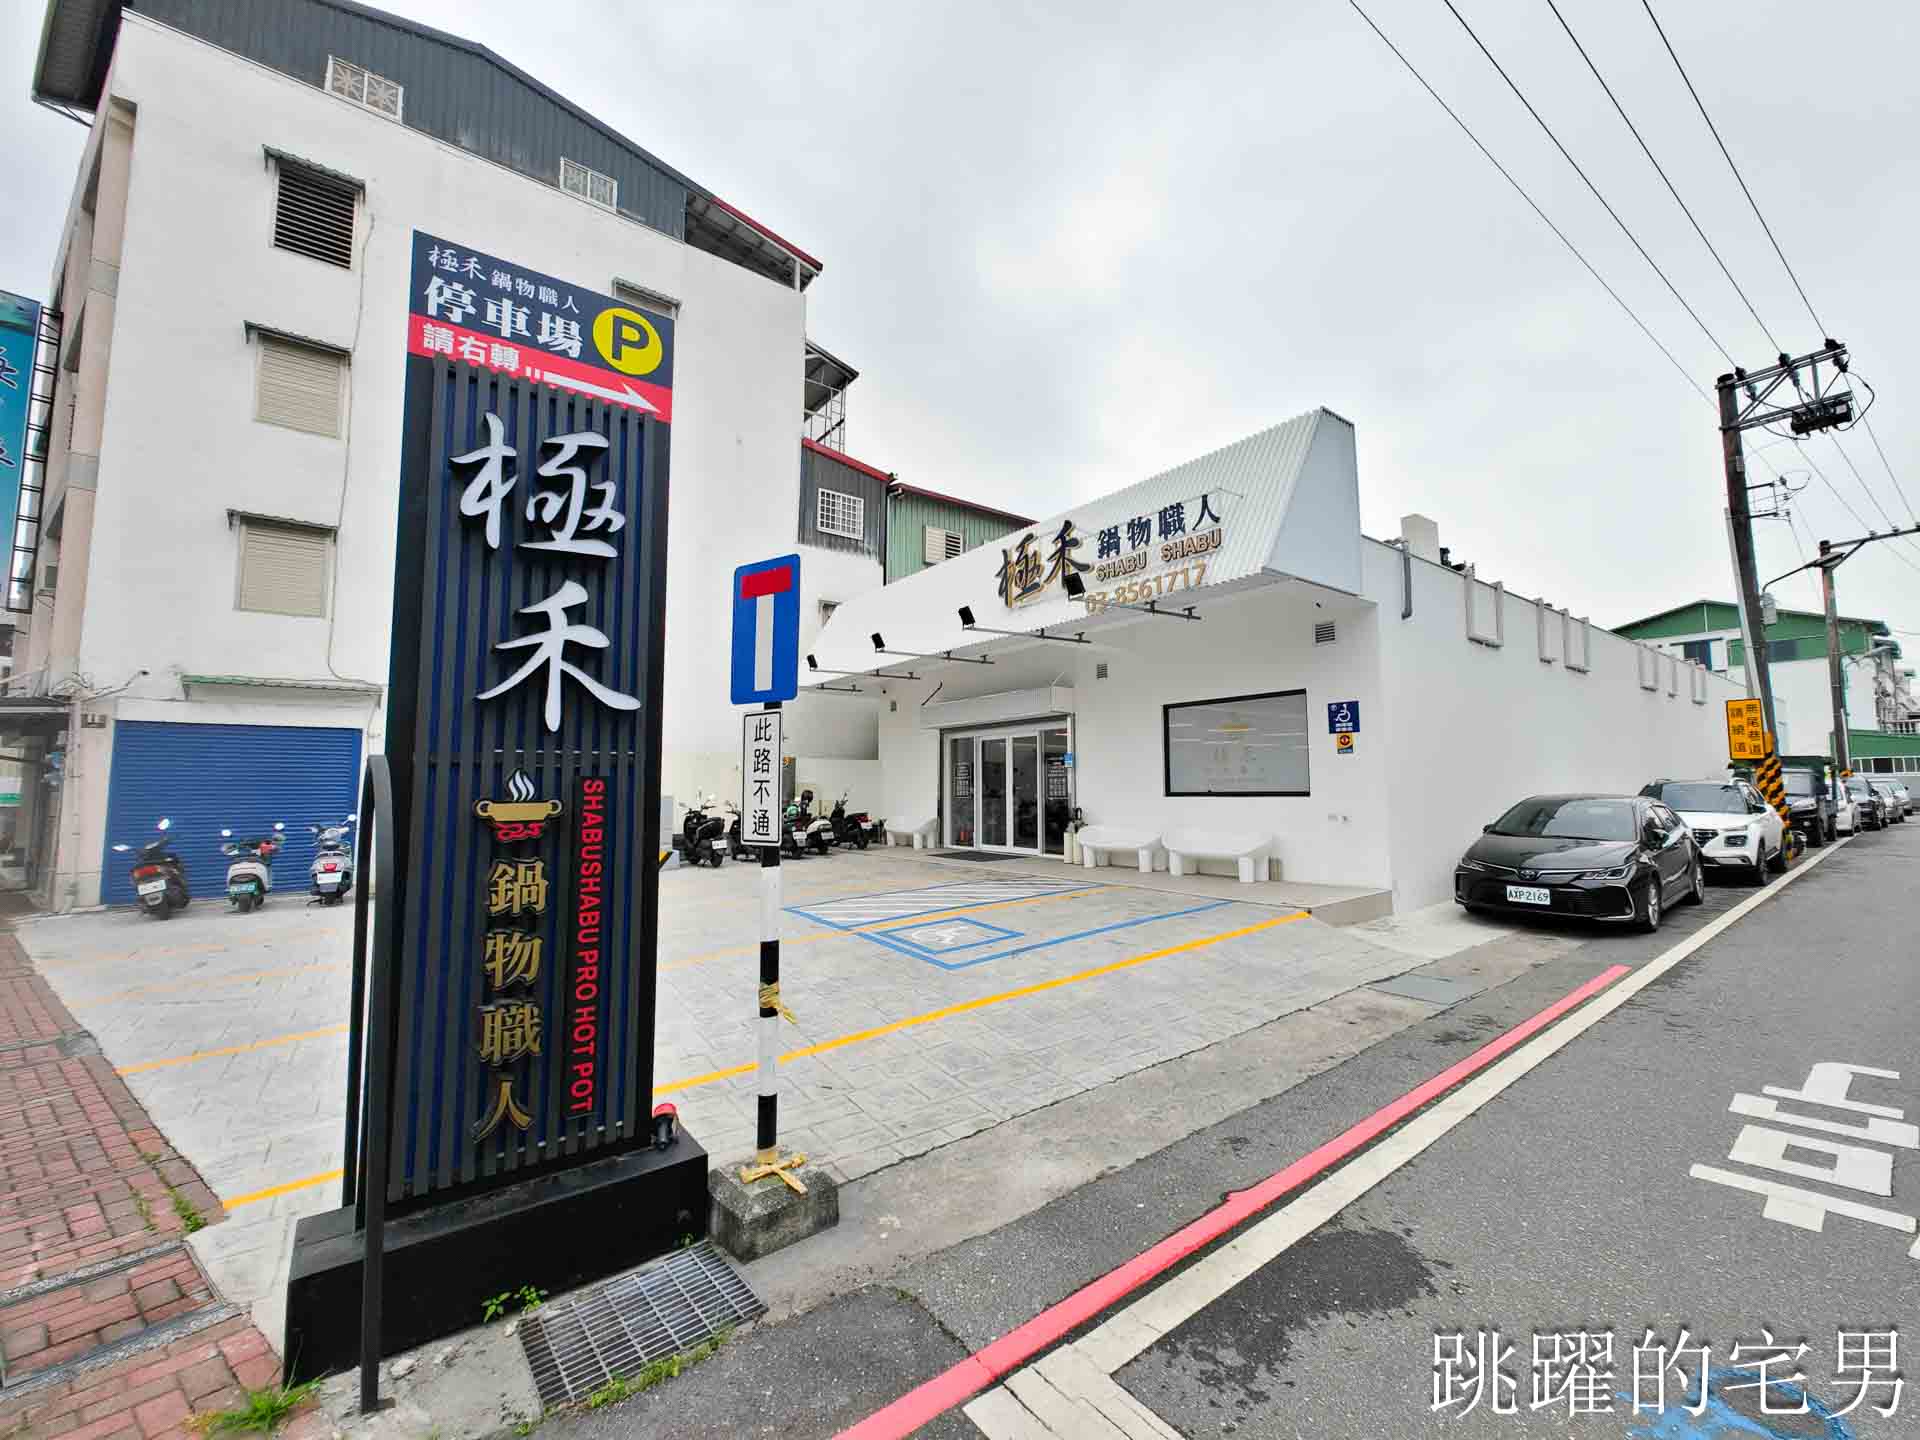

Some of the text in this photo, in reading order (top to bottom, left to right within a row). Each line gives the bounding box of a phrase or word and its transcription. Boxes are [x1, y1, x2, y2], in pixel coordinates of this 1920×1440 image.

[423, 275, 583, 359] 停車場
[429, 246, 580, 314] 極禾 鍋物職人
[422, 323, 519, 372] 請右轉
[1096, 494, 1221, 558] 鍋物職人
[1096, 528, 1222, 581] SHABU SHABU
[751, 717, 773, 836] 此路不通
[570, 778, 605, 1112] SHABUSHABU PRO HOT POT
[475, 859, 550, 1142] 鍋物職人
